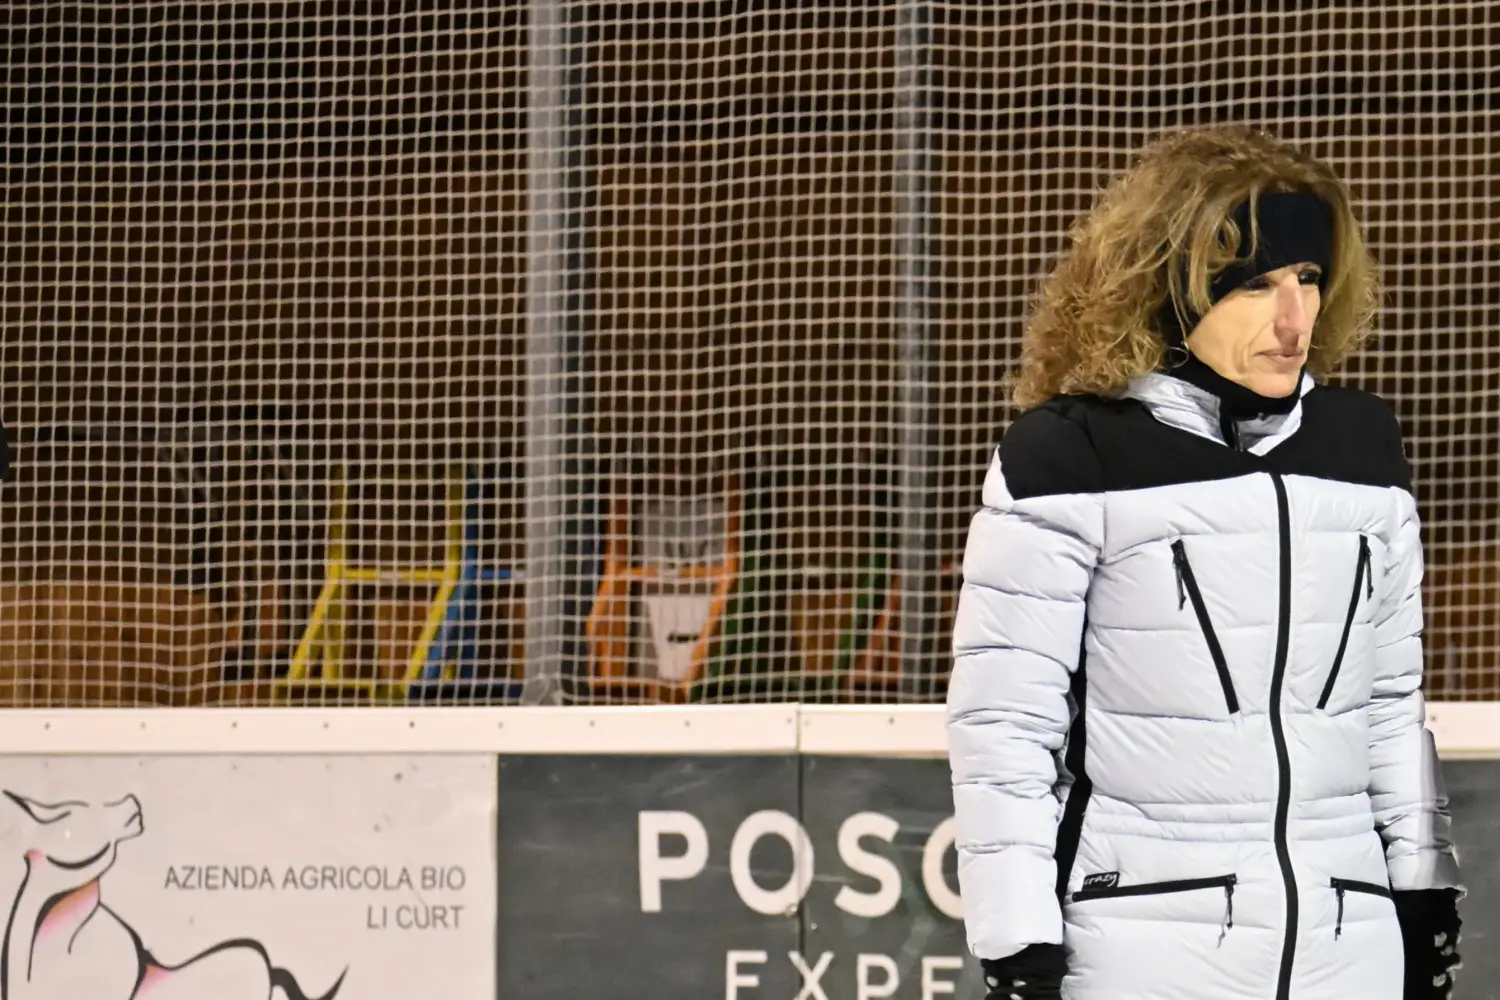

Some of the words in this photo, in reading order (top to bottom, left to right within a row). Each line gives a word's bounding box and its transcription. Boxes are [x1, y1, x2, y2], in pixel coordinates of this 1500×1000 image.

[164, 865, 275, 890] AZIENDA
[282, 865, 412, 890] AGRICOLA
[421, 866, 466, 890] BIO
[367, 905, 388, 929] LI
[395, 905, 464, 929] CURT
